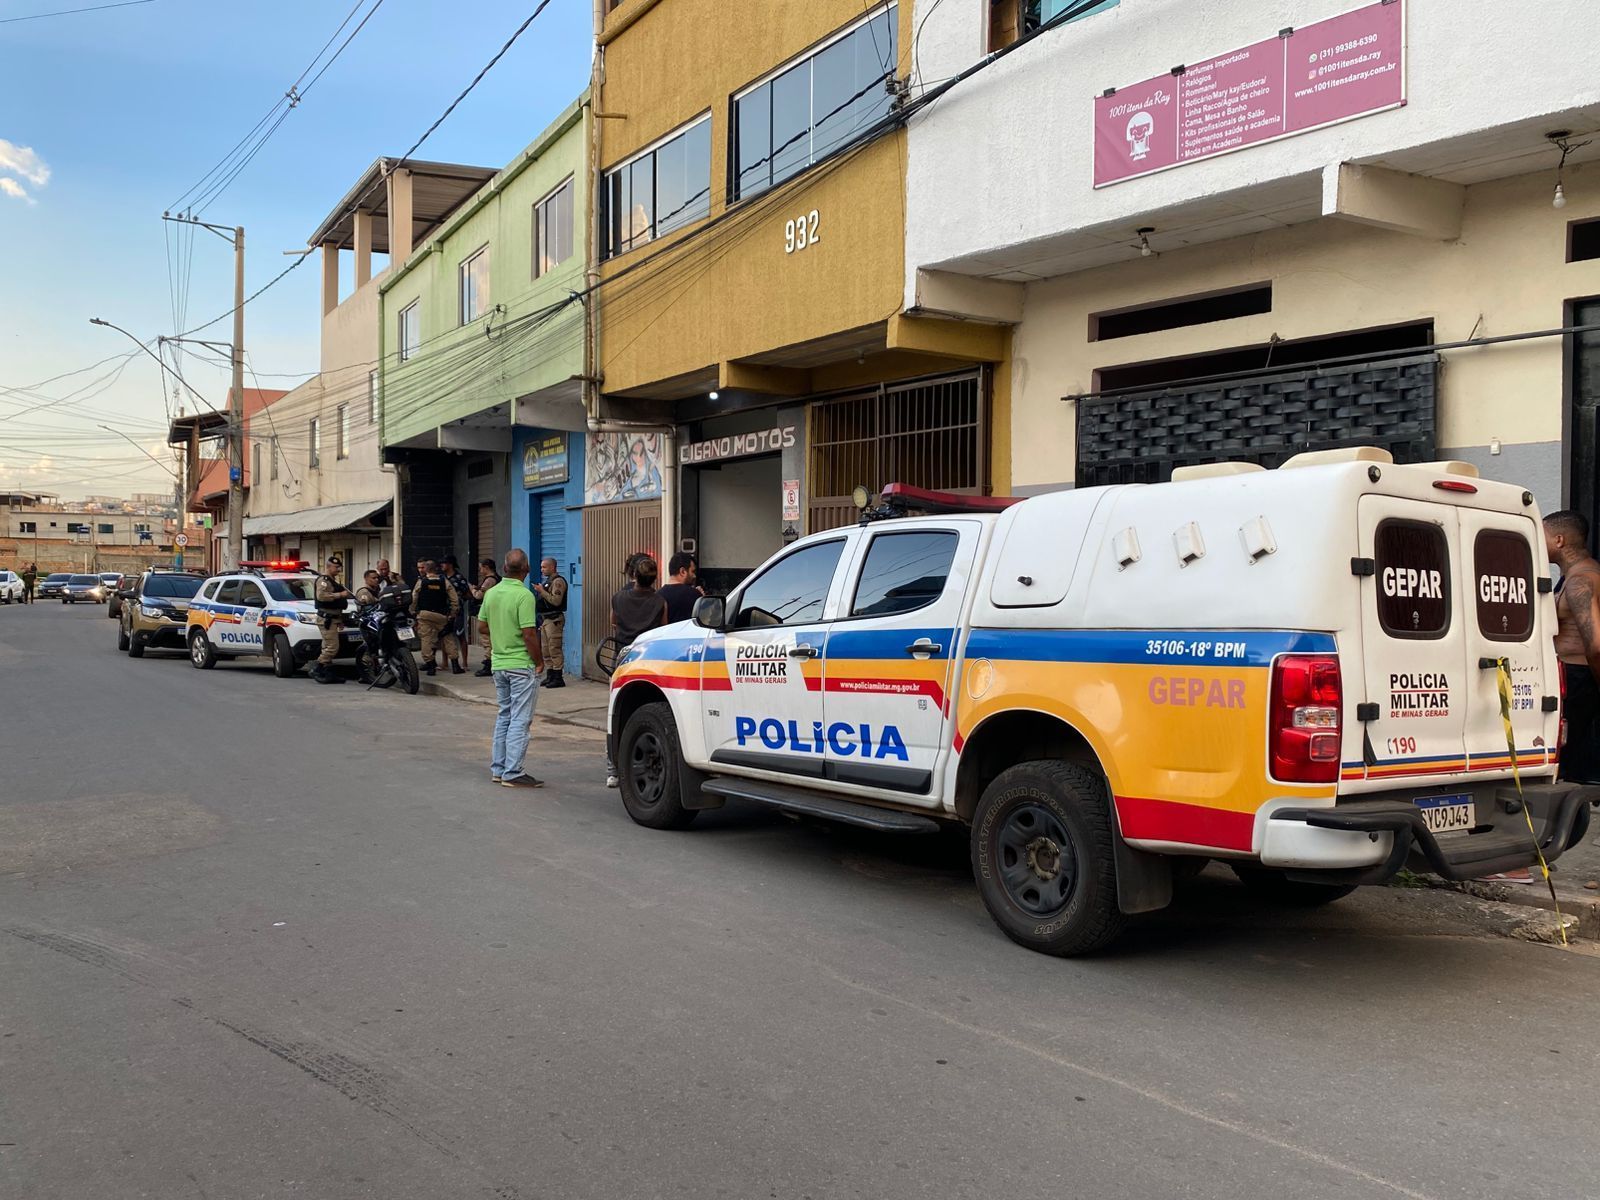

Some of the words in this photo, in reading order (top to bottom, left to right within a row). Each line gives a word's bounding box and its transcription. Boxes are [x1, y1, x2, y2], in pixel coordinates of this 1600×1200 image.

[1319, 47, 1334, 60] (31)
[1335, 33, 1378, 54] 99388-6390
[1185, 63, 1214, 77] Perfumes
[1294, 62, 1397, 98] www.1001itensdaray.com.br
[1185, 81, 1217, 98] Rommanel
[1109, 106, 1126, 119] 1001
[1127, 102, 1143, 113] itens
[1144, 97, 1154, 108] da
[1153, 90, 1171, 106] Ray
[1185, 107, 1202, 118] Linha
[1240, 93, 1249, 102] de
[1249, 87, 1270, 100] cheiro
[1204, 112, 1221, 122] Mesa
[1226, 104, 1248, 116] Banho
[1184, 128, 1197, 138] Kits
[1197, 117, 1237, 135] profissionais
[1237, 114, 1246, 122] de
[1184, 131, 1223, 148] Suplementos
[1249, 114, 1281, 129] academia
[1184, 148, 1201, 157] Moda
[1202, 145, 1212, 153] em
[1212, 136, 1242, 151] Academia
[785, 209, 820, 254] 932
[680, 437, 730, 462] CIGANO
[733, 426, 796, 456] MOTOS
[176, 535, 187, 543] 30
[1382, 566, 1443, 599] GEPAR
[1479, 574, 1528, 605] GEPAR
[688, 643, 703, 654] 190
[1214, 642, 1246, 659] BPM
[735, 662, 787, 676] MILITAR
[735, 676, 743, 684] DE
[744, 676, 763, 684] MINAS
[839, 681, 921, 693] www.policiamilitar.mg.gov.br
[1148, 676, 1246, 709] GEPAR
[1513, 684, 1532, 696] 35106
[1390, 692, 1449, 710] MILITAR
[1521, 698, 1534, 710] BPM
[1390, 710, 1400, 719] DE
[1401, 710, 1423, 718] MINAS
[1424, 709, 1449, 718] GERAIS
[1392, 736, 1417, 755] 190
